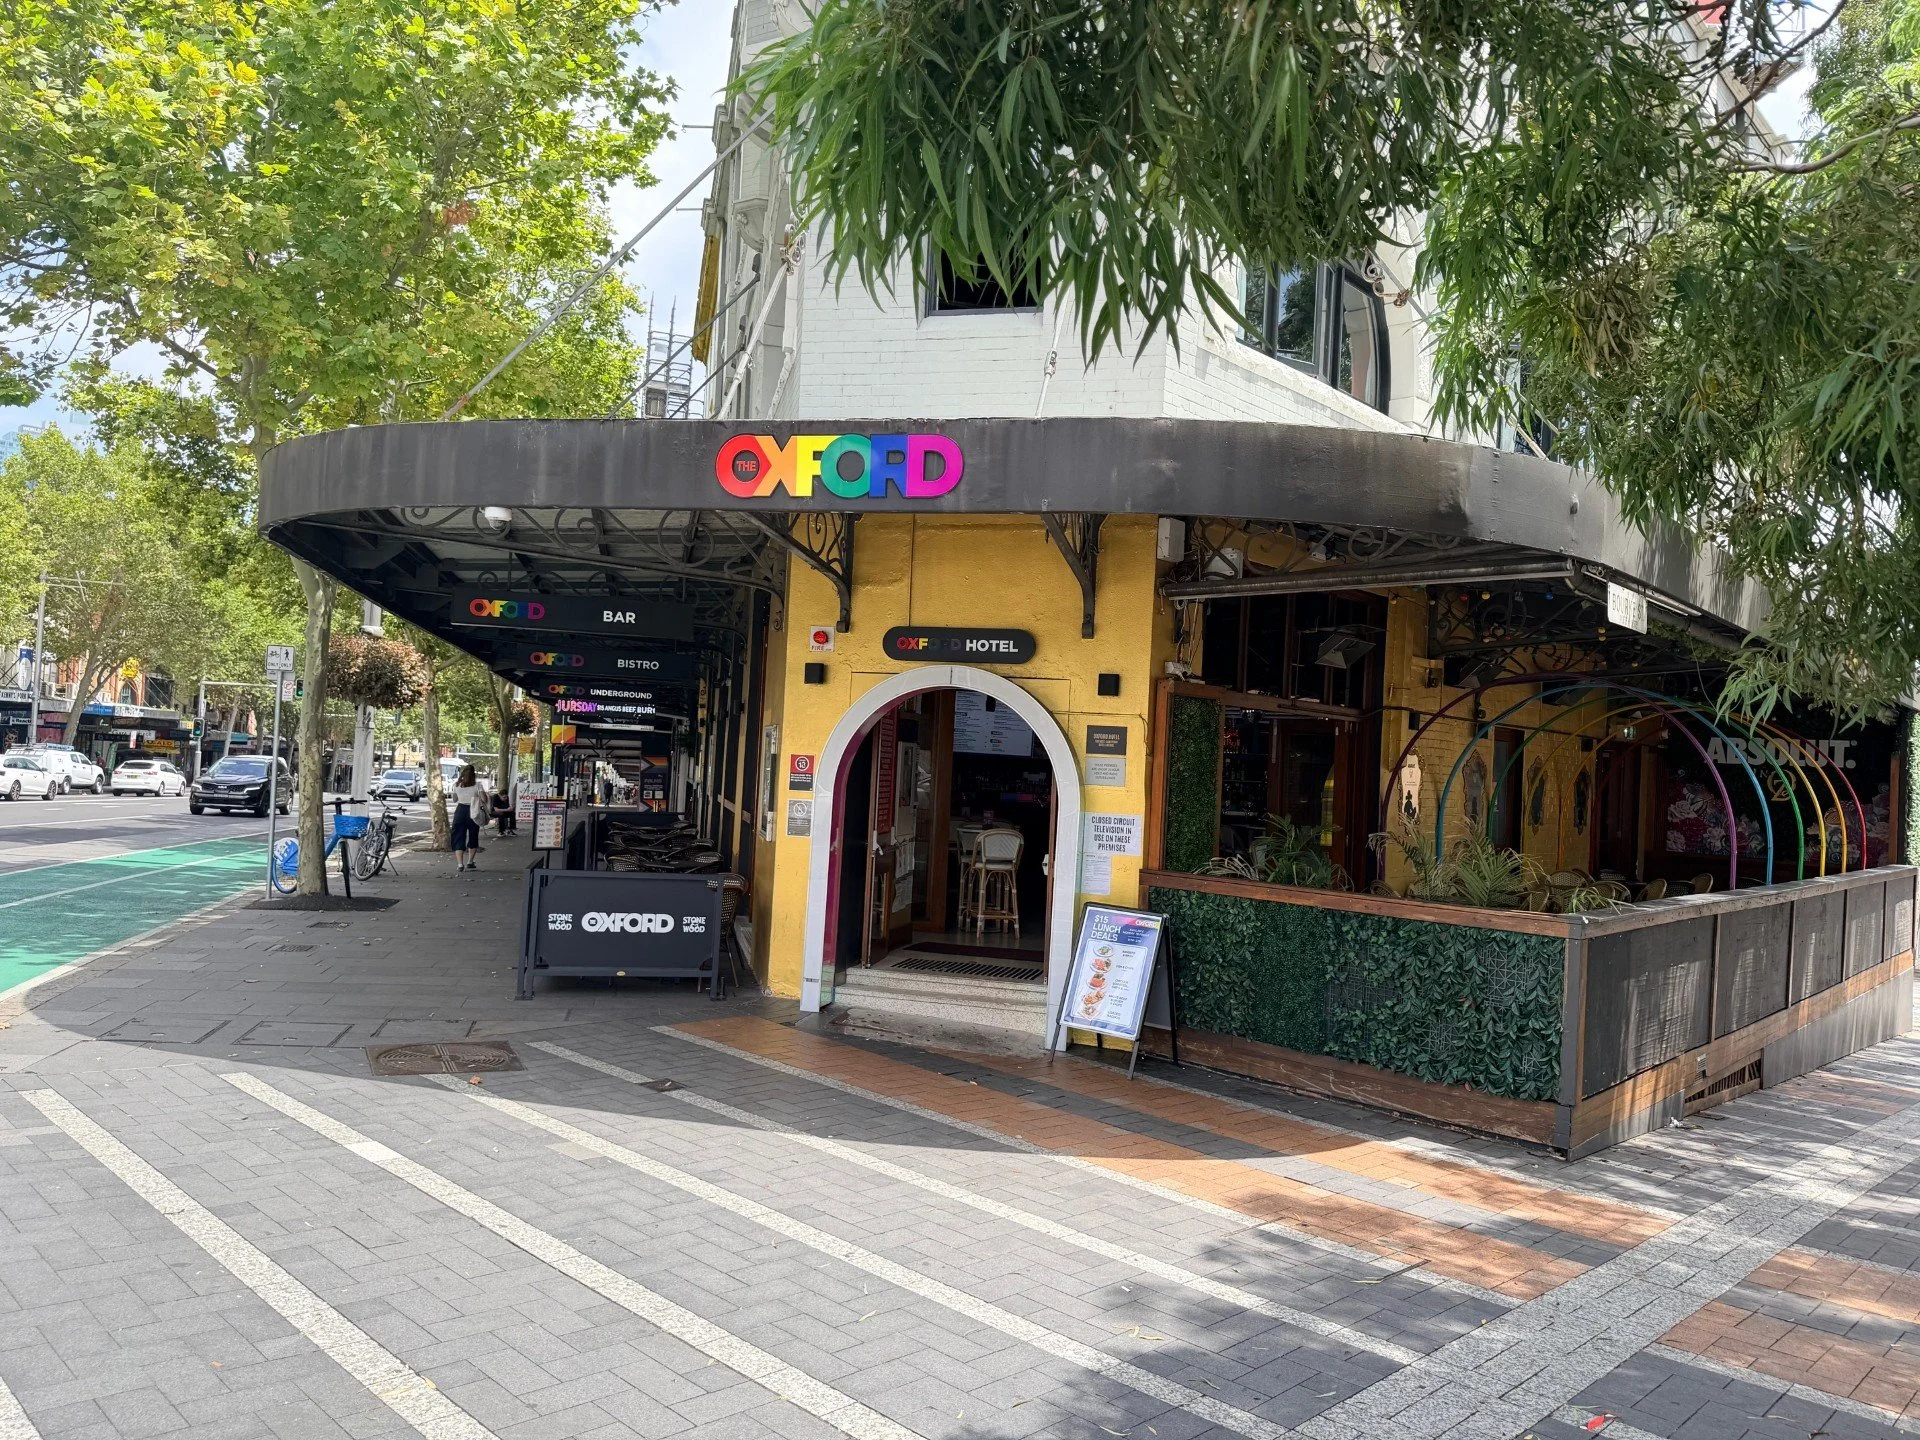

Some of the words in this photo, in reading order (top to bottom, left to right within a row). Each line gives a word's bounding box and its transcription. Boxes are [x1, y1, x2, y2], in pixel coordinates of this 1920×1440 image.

[715, 433, 965, 498] OXFORD
[736, 460, 757, 472] THE
[602, 610, 636, 624] BAR
[896, 637, 962, 650] OXFOD
[965, 639, 1019, 653] HOTEL
[617, 658, 660, 670] BISTRO
[548, 684, 585, 695] OXFOD
[590, 688, 653, 700] UNDERGROUND
[1091, 816, 1112, 825] CLOSED
[1113, 817, 1135, 826] CIRCUIT
[1094, 825, 1124, 834] TELEVISION
[1125, 827, 1132, 835] IN
[1094, 834, 1104, 842] USE
[1105, 834, 1114, 842] ON
[1114, 835, 1131, 843] THESE
[1097, 843, 1126, 852] PREMISES
[581, 911, 675, 933] OXFORD
[682, 916, 707, 924] STONE
[1094, 914, 1109, 924] $15
[682, 925, 705, 933] WOOD
[1092, 923, 1121, 934] LUNCH
[1090, 931, 1119, 942] DEALS
